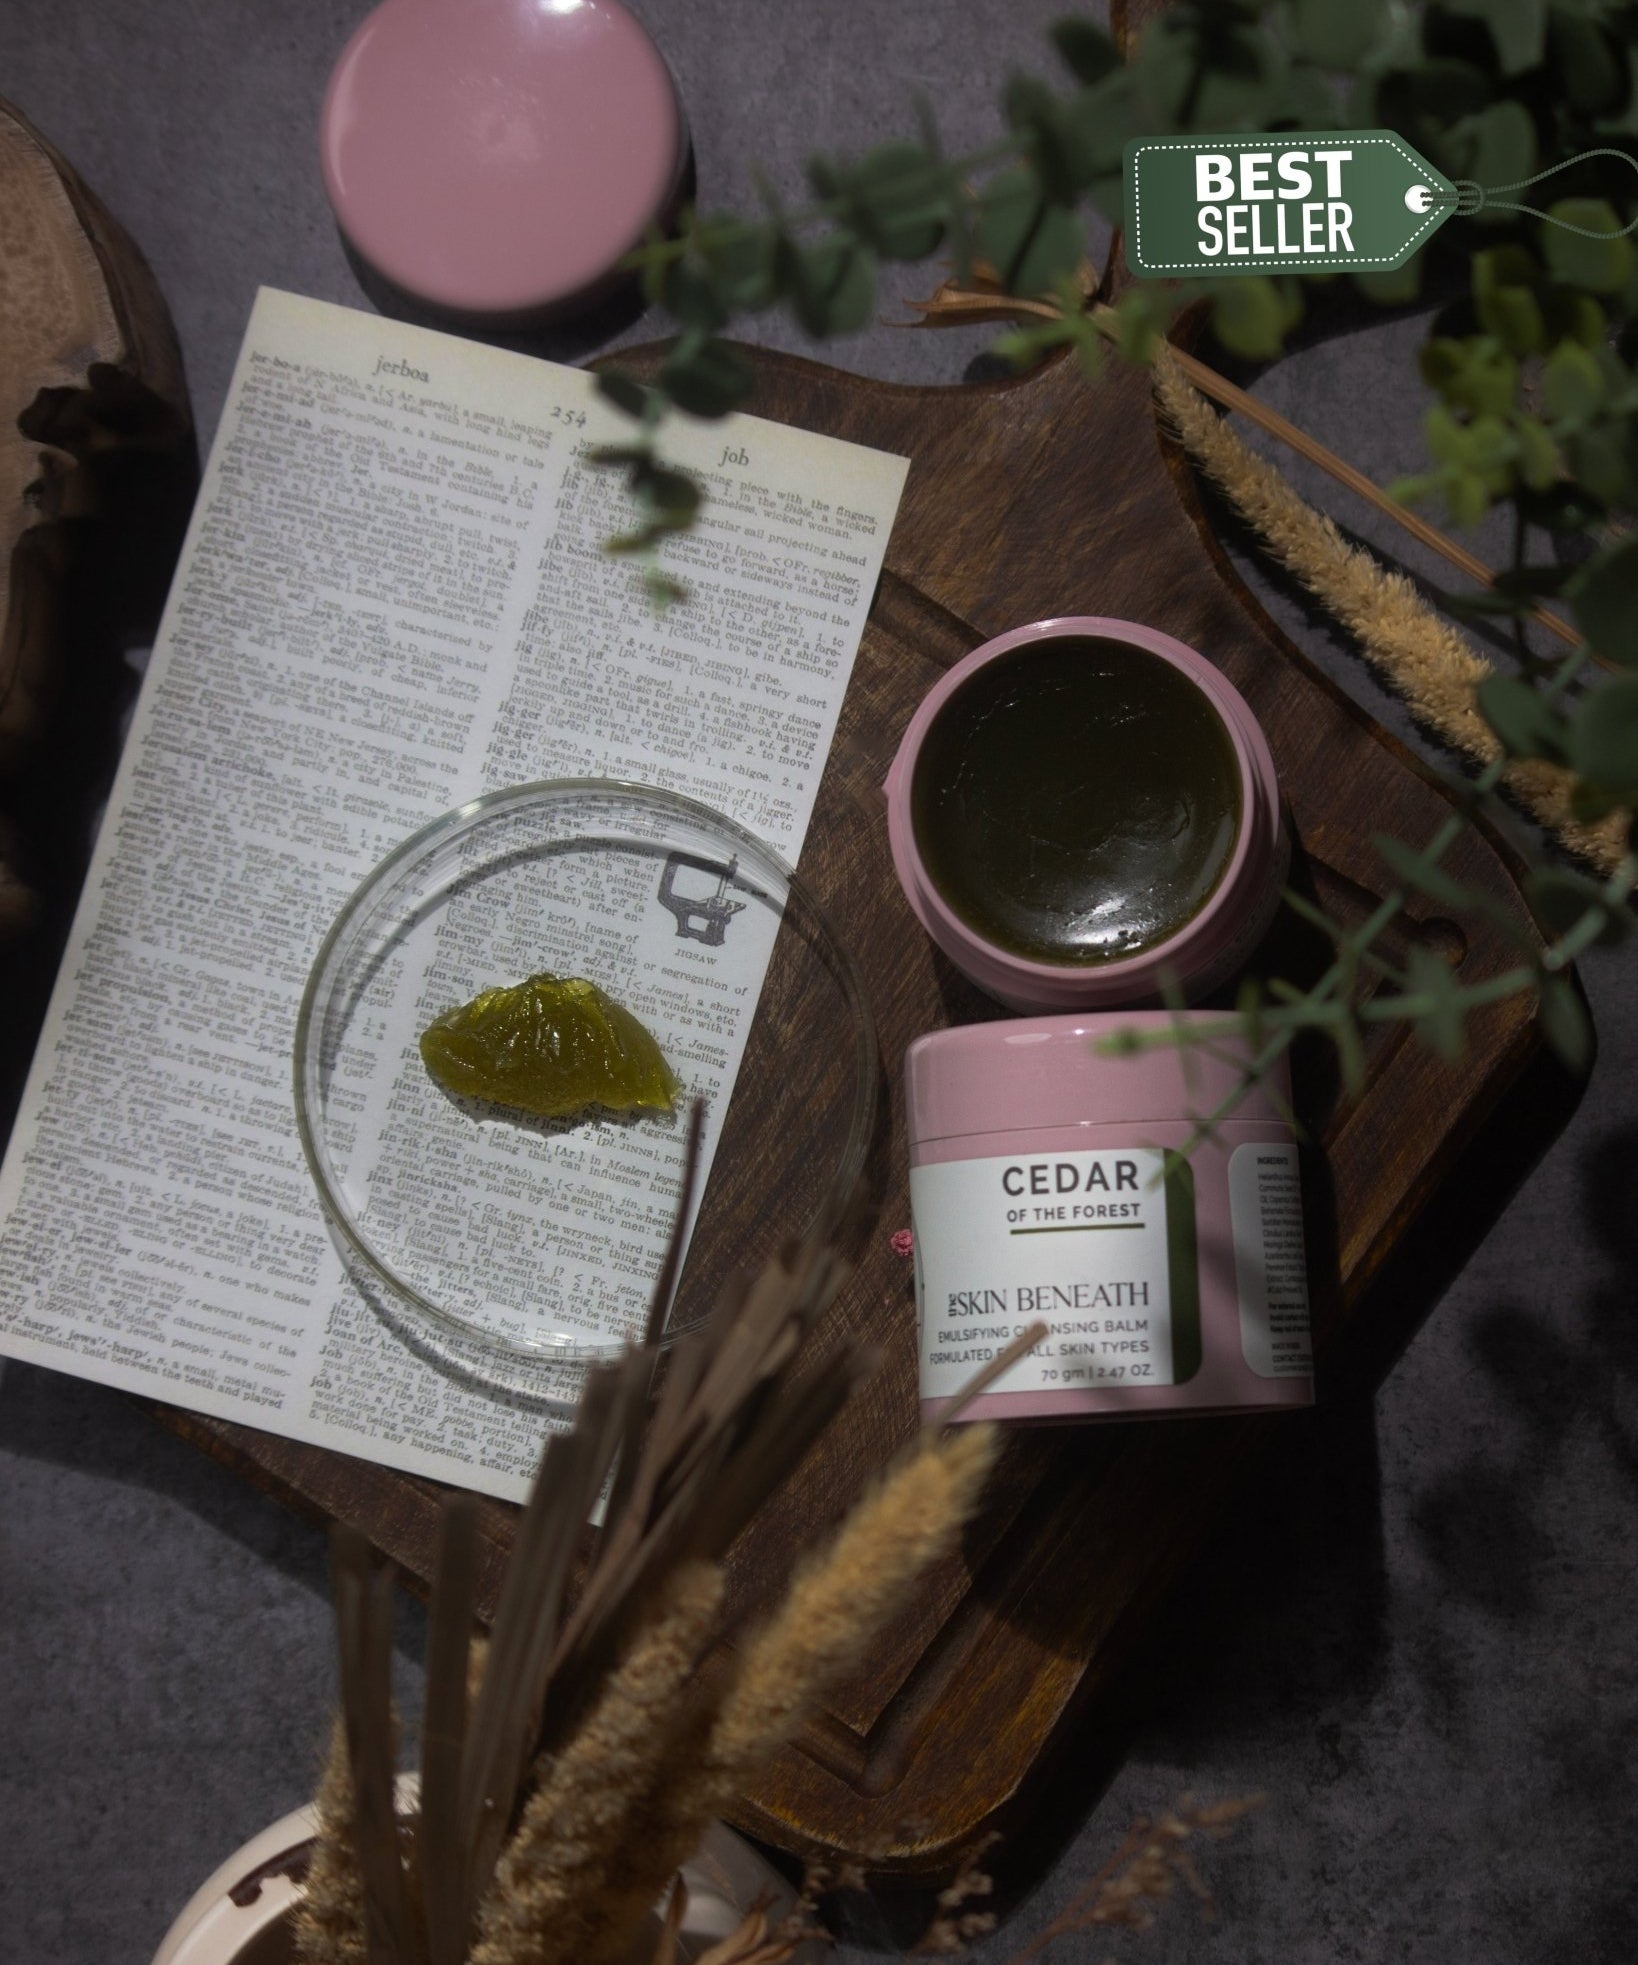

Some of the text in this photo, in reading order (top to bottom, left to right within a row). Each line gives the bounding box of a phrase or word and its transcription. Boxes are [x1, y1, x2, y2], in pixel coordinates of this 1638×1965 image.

[372, 355, 430, 383] jerboa
[549, 404, 588, 429] 254
[718, 445, 750, 468] job
[663, 547, 858, 606] backward or sideways instead of
[705, 548, 717, 559] to
[721, 554, 736, 563] go
[794, 573, 807, 582] as
[810, 578, 818, 586] a
[536, 591, 560, 604] that
[565, 599, 584, 611] the
[587, 606, 613, 619] sails
[728, 642, 740, 652] to
[744, 646, 758, 657] be
[762, 651, 774, 662] in
[538, 583, 581, 599] and-aft
[638, 607, 650, 618] to
[653, 611, 695, 631] change
[701, 624, 720, 636] the
[724, 632, 762, 647] course
[767, 643, 781, 652] of
[783, 647, 791, 655] a
[795, 650, 820, 664] ship
[824, 659, 838, 668] so
[519, 652, 530, 662] in
[534, 656, 565, 672] triple
[617, 679, 652, 694] music
[654, 688, 672, 700] for
[672, 695, 700, 708] such
[770, 721, 778, 729] a
[781, 723, 819, 739] device
[496, 734, 522, 748] used
[526, 741, 538, 752] to
[541, 747, 590, 766] measure
[656, 776, 674, 789] the
[678, 783, 728, 803] contents
[731, 798, 745, 807] of
[746, 802, 754, 811] a
[446, 897, 464, 908] an
[469, 903, 499, 918] early
[504, 911, 540, 928] Negro
[545, 923, 594, 943] minstrel
[505, 923, 588, 953] discrimination
[594, 947, 638, 966] against
[642, 962, 656, 971] or
[660, 966, 728, 991] segregation
[734, 986, 748, 996] of
[674, 948, 719, 965] JIGSAW
[379, 1153, 424, 1172] oriental
[485, 1182, 521, 1199] pulled
[527, 1192, 543, 1205] by
[548, 1200, 570, 1212] one
[574, 1207, 588, 1216] or
[592, 1210, 615, 1224] two
[1002, 1160, 1139, 1197] CEDAR
[1006, 1203, 1141, 1223] OF THE FOREST
[957, 1289, 1007, 1318] SKIN
[1017, 1281, 1149, 1312] BENEATH
[938, 1319, 1148, 1343] EMULSIFYING CNSING BALM
[929, 1348, 992, 1366] FORMULATED
[1059, 1342, 1095, 1356] SKIN
[1101, 1340, 1149, 1354] TYPES
[1041, 1369, 1058, 1382] 70
[1062, 1369, 1085, 1382] gm
[1098, 1366, 1126, 1379] 2.47
[322, 1358, 572, 1433] much suffering but did not lose his faith
[311, 1400, 361, 1420] material
[365, 1413, 398, 1431] being
[402, 1425, 445, 1443] worked
